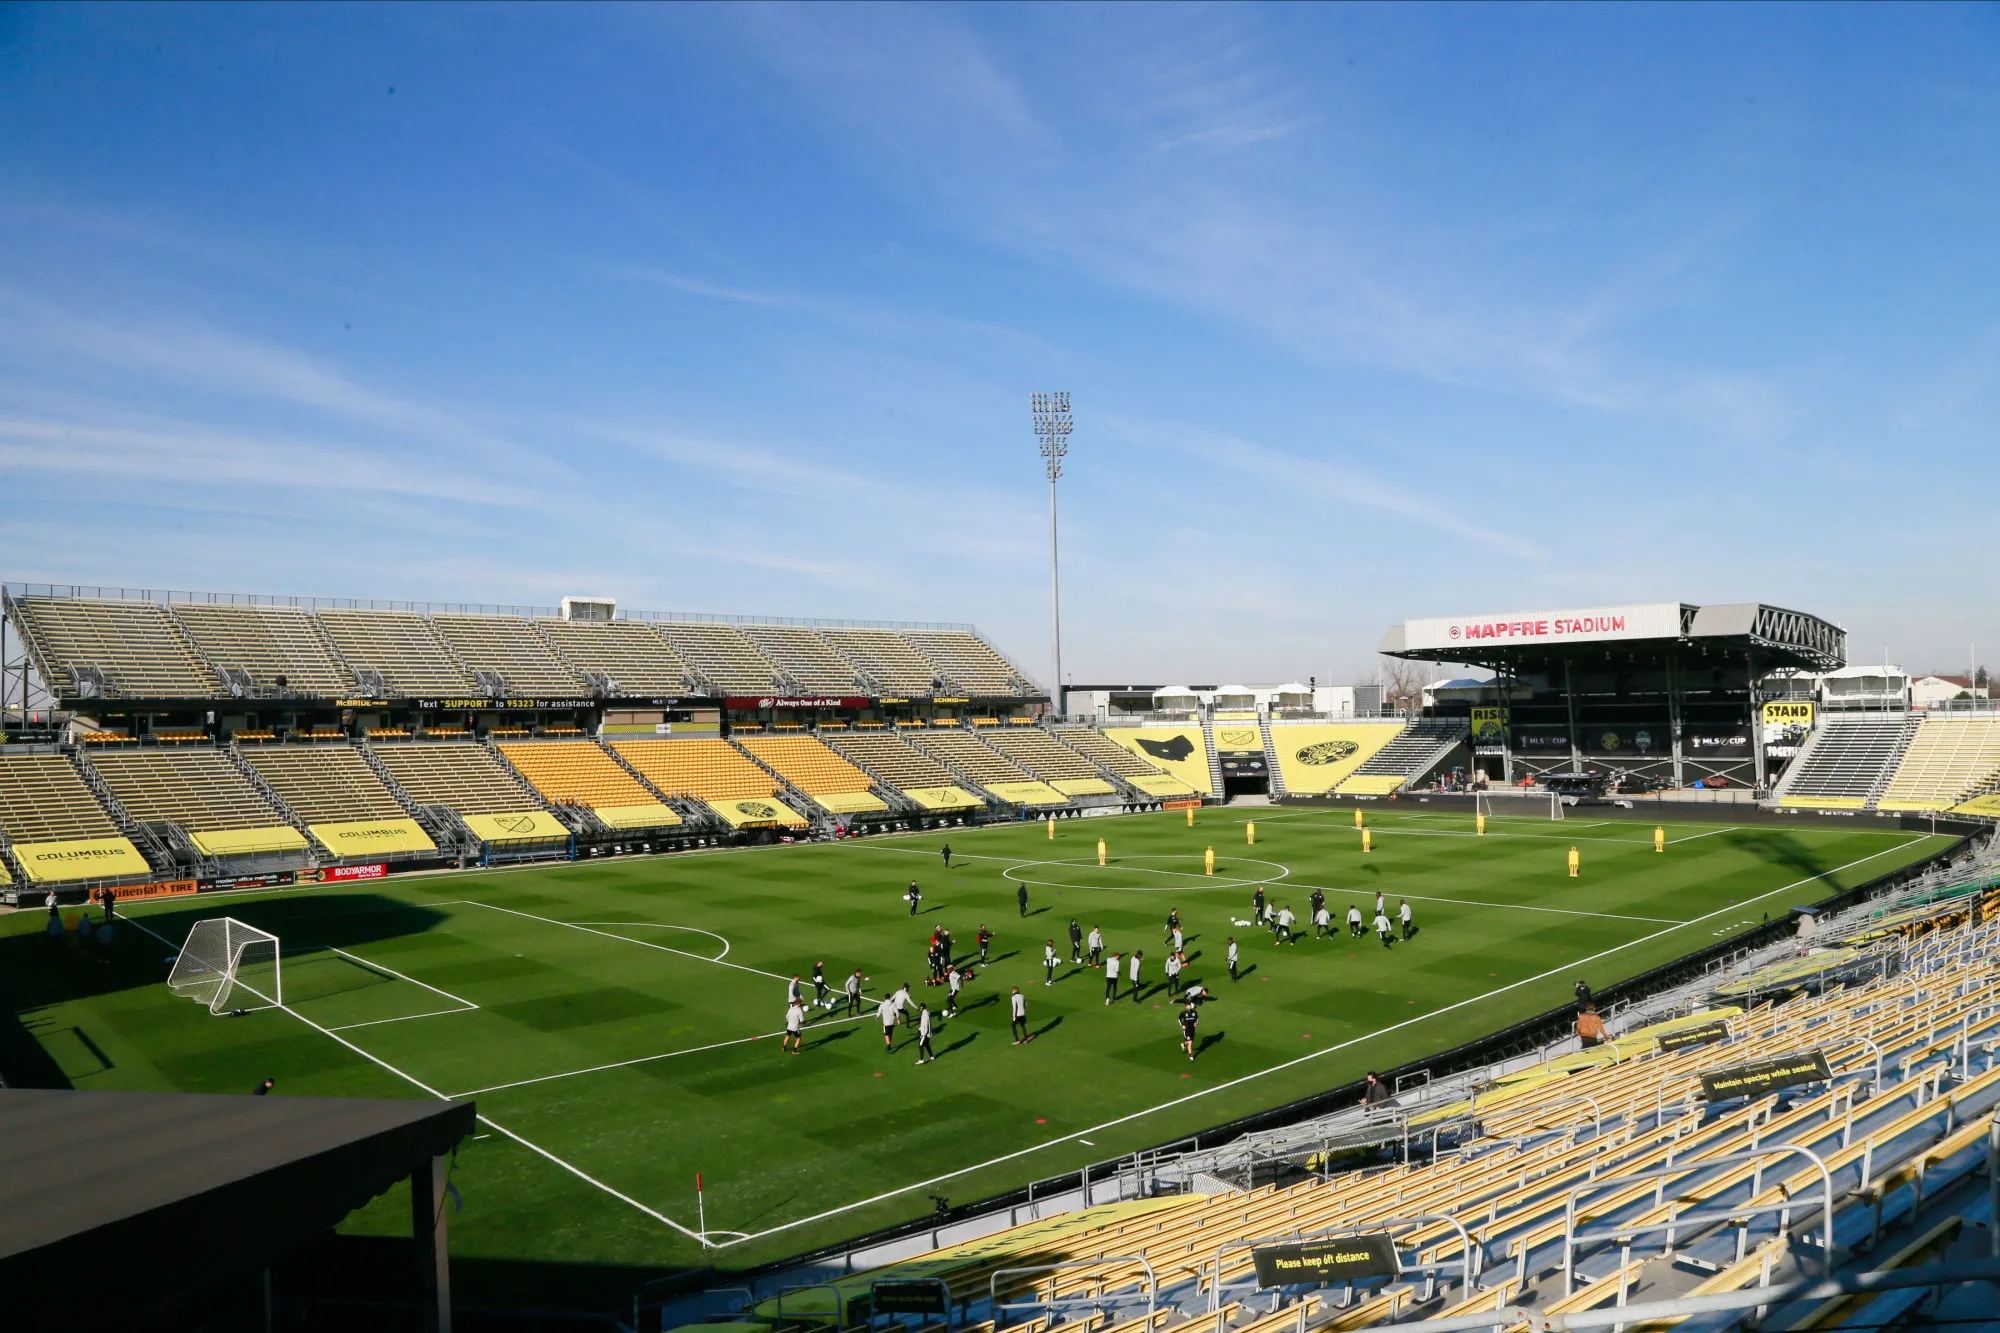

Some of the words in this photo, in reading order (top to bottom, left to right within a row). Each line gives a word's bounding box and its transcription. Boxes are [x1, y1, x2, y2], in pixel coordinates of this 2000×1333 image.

[1465, 620, 1548, 639] MAPFRE
[1554, 616, 1625, 634] STADIUM
[418, 700, 438, 708] Text
[776, 699, 799, 707] Always
[1766, 706, 1808, 716] STAND
[339, 829, 408, 838] COLUMBUS
[36, 848, 125, 861] COLUMBUS
[335, 865, 382, 876] BODYARMOR
[94, 882, 158, 901] Ctinental
[170, 883, 193, 892] TIRE
[1714, 1078, 1743, 1090] Maintain
[1744, 1073, 1770, 1086] spacing
[1771, 1068, 1791, 1079] while
[1792, 1062, 1817, 1074] seated
[1276, 1258, 1301, 1270] Please
[1302, 1256, 1322, 1268] keep
[1324, 1254, 1334, 1265] 6ft
[1336, 1251, 1370, 1264] distance
